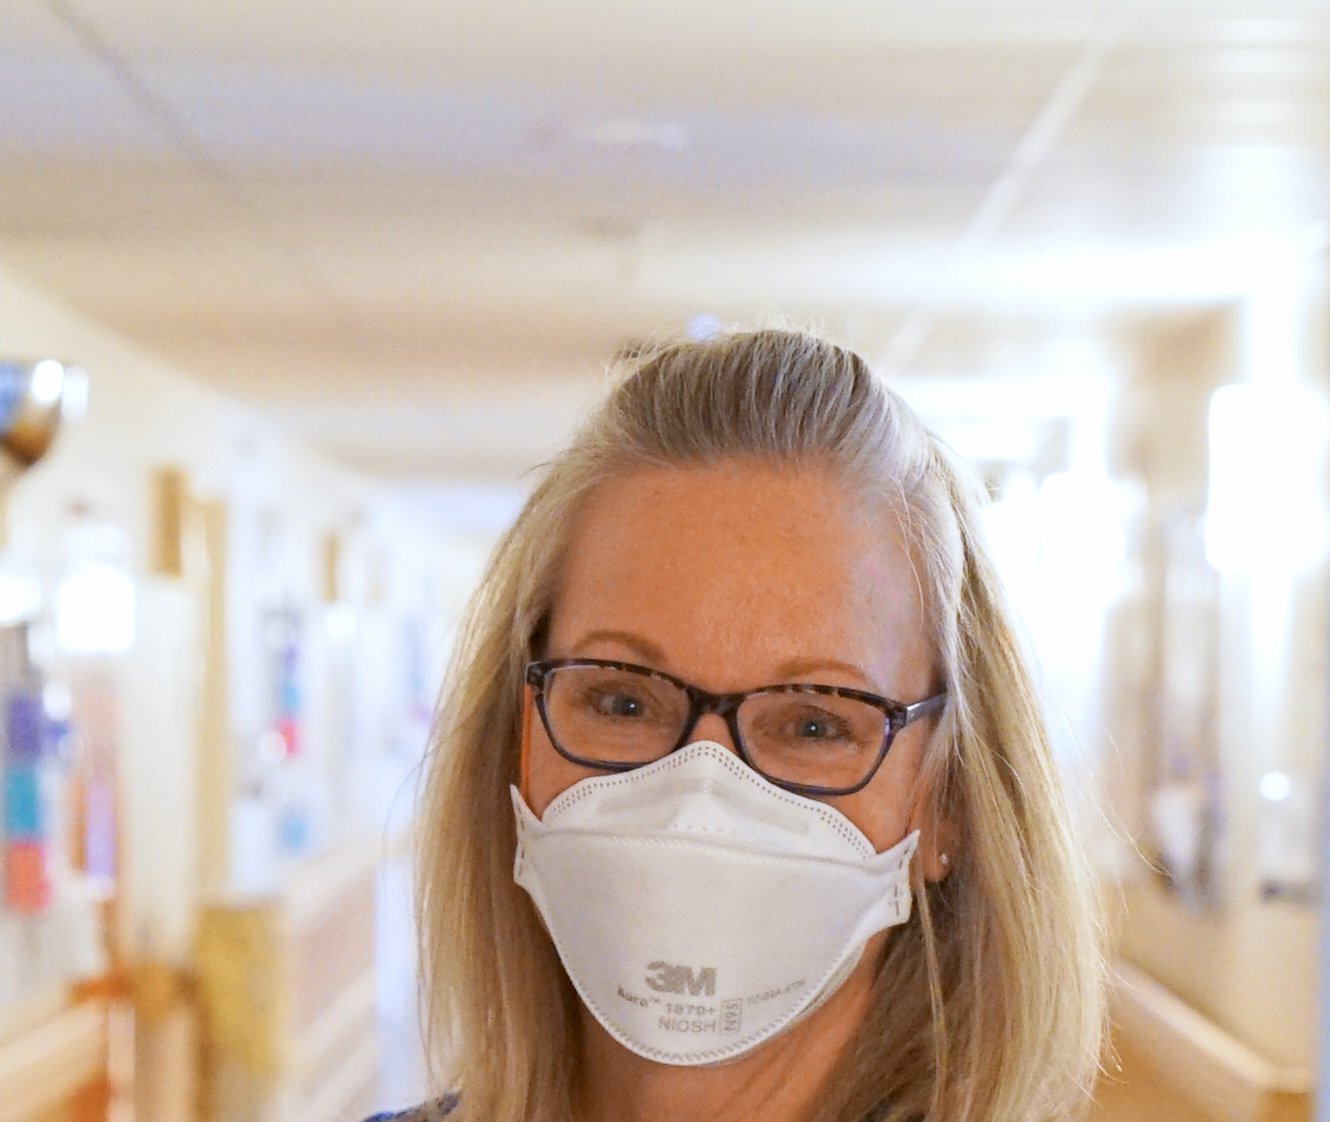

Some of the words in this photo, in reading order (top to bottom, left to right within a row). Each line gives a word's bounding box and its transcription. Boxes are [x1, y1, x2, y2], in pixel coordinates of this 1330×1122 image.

[645, 960, 717, 996] 3M
[665, 1001, 716, 1016] 1870+
[724, 1002, 739, 1032] N95
[658, 1016, 718, 1034] NIOSH
